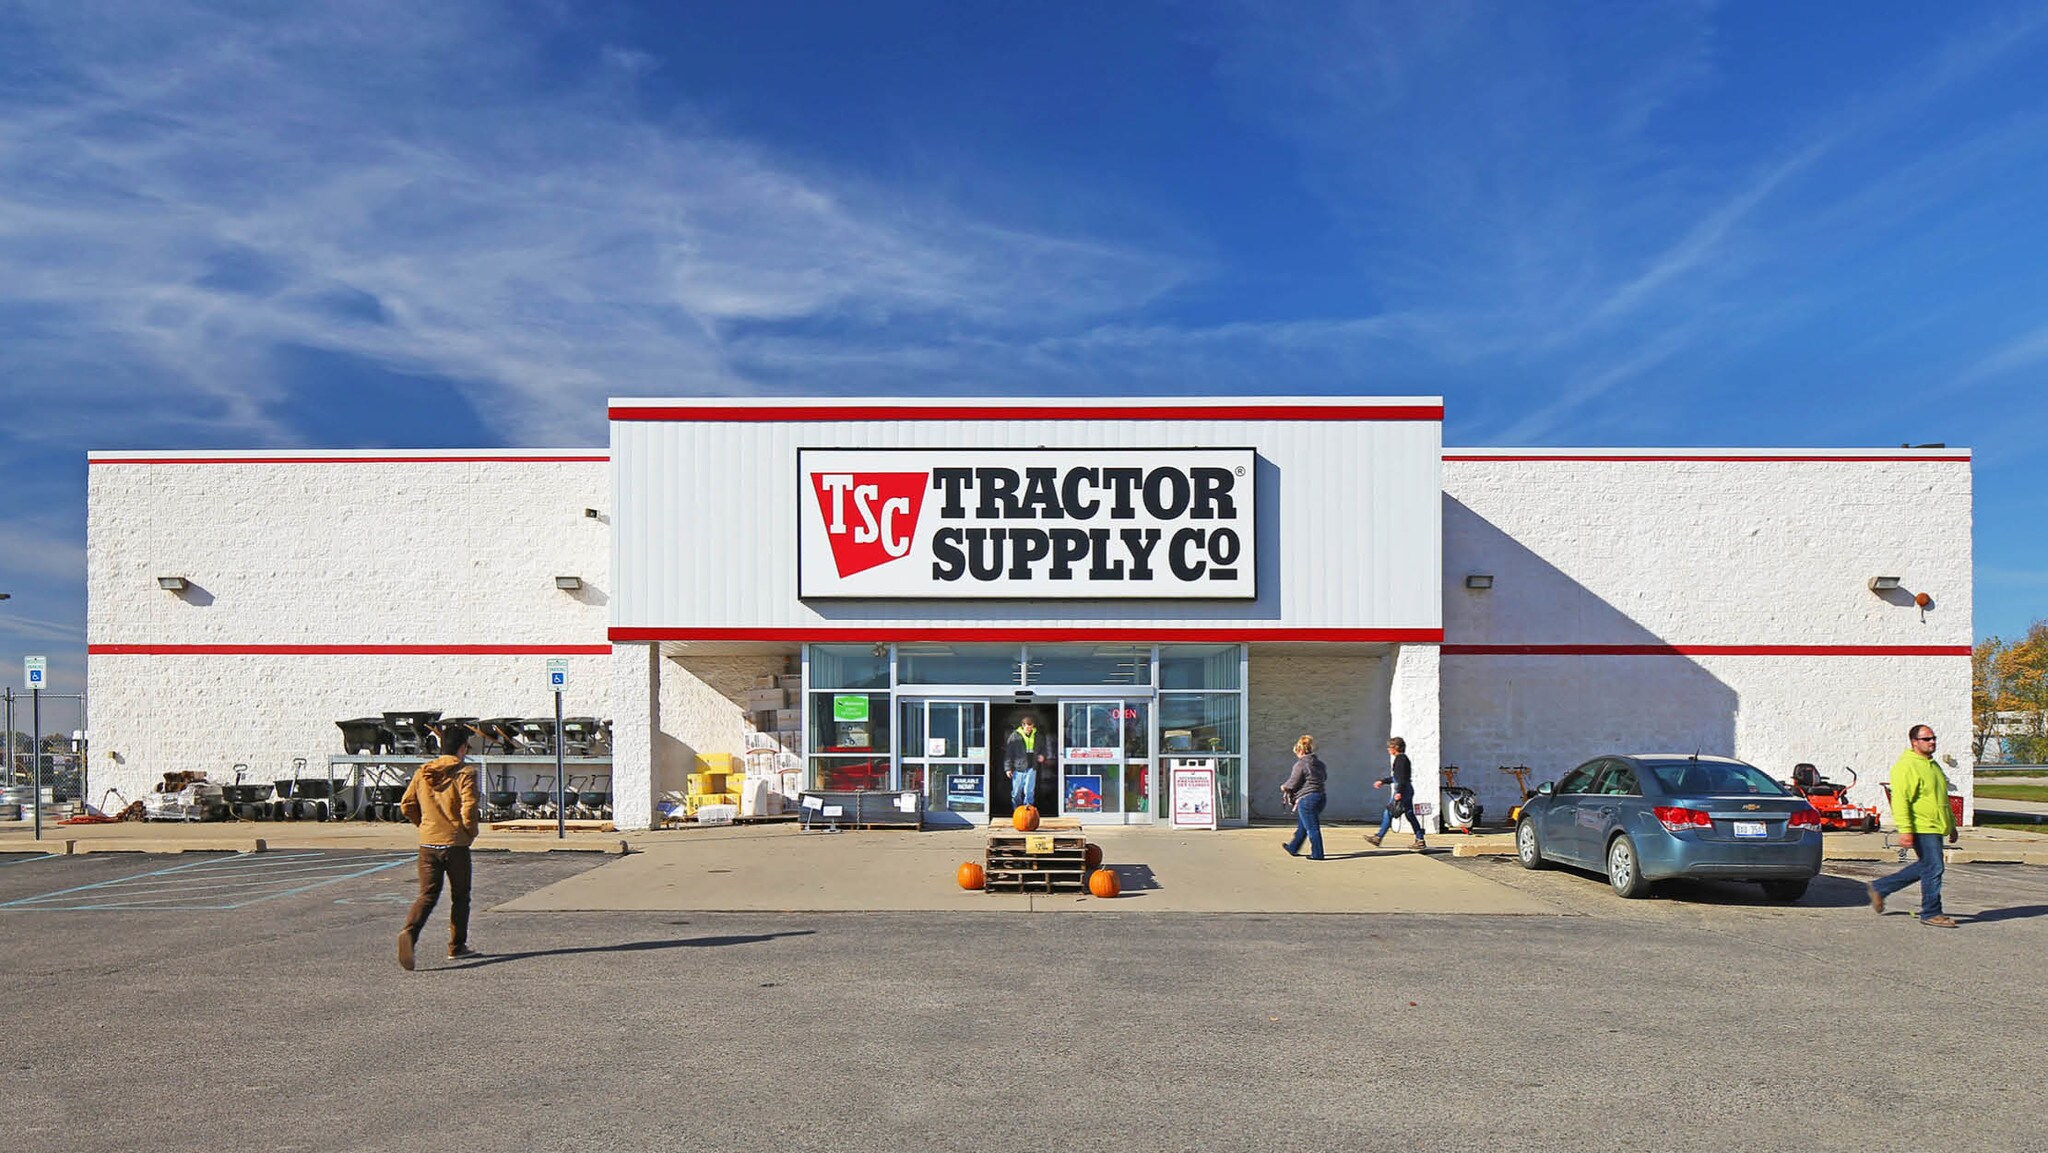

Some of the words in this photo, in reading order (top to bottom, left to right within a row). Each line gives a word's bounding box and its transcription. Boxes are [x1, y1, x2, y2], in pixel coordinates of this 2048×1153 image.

[822, 474, 909, 557] TSC
[932, 467, 1237, 519] TRACTOR
[932, 527, 1161, 581] SUPPLY
[1112, 709, 1137, 719] OEN
